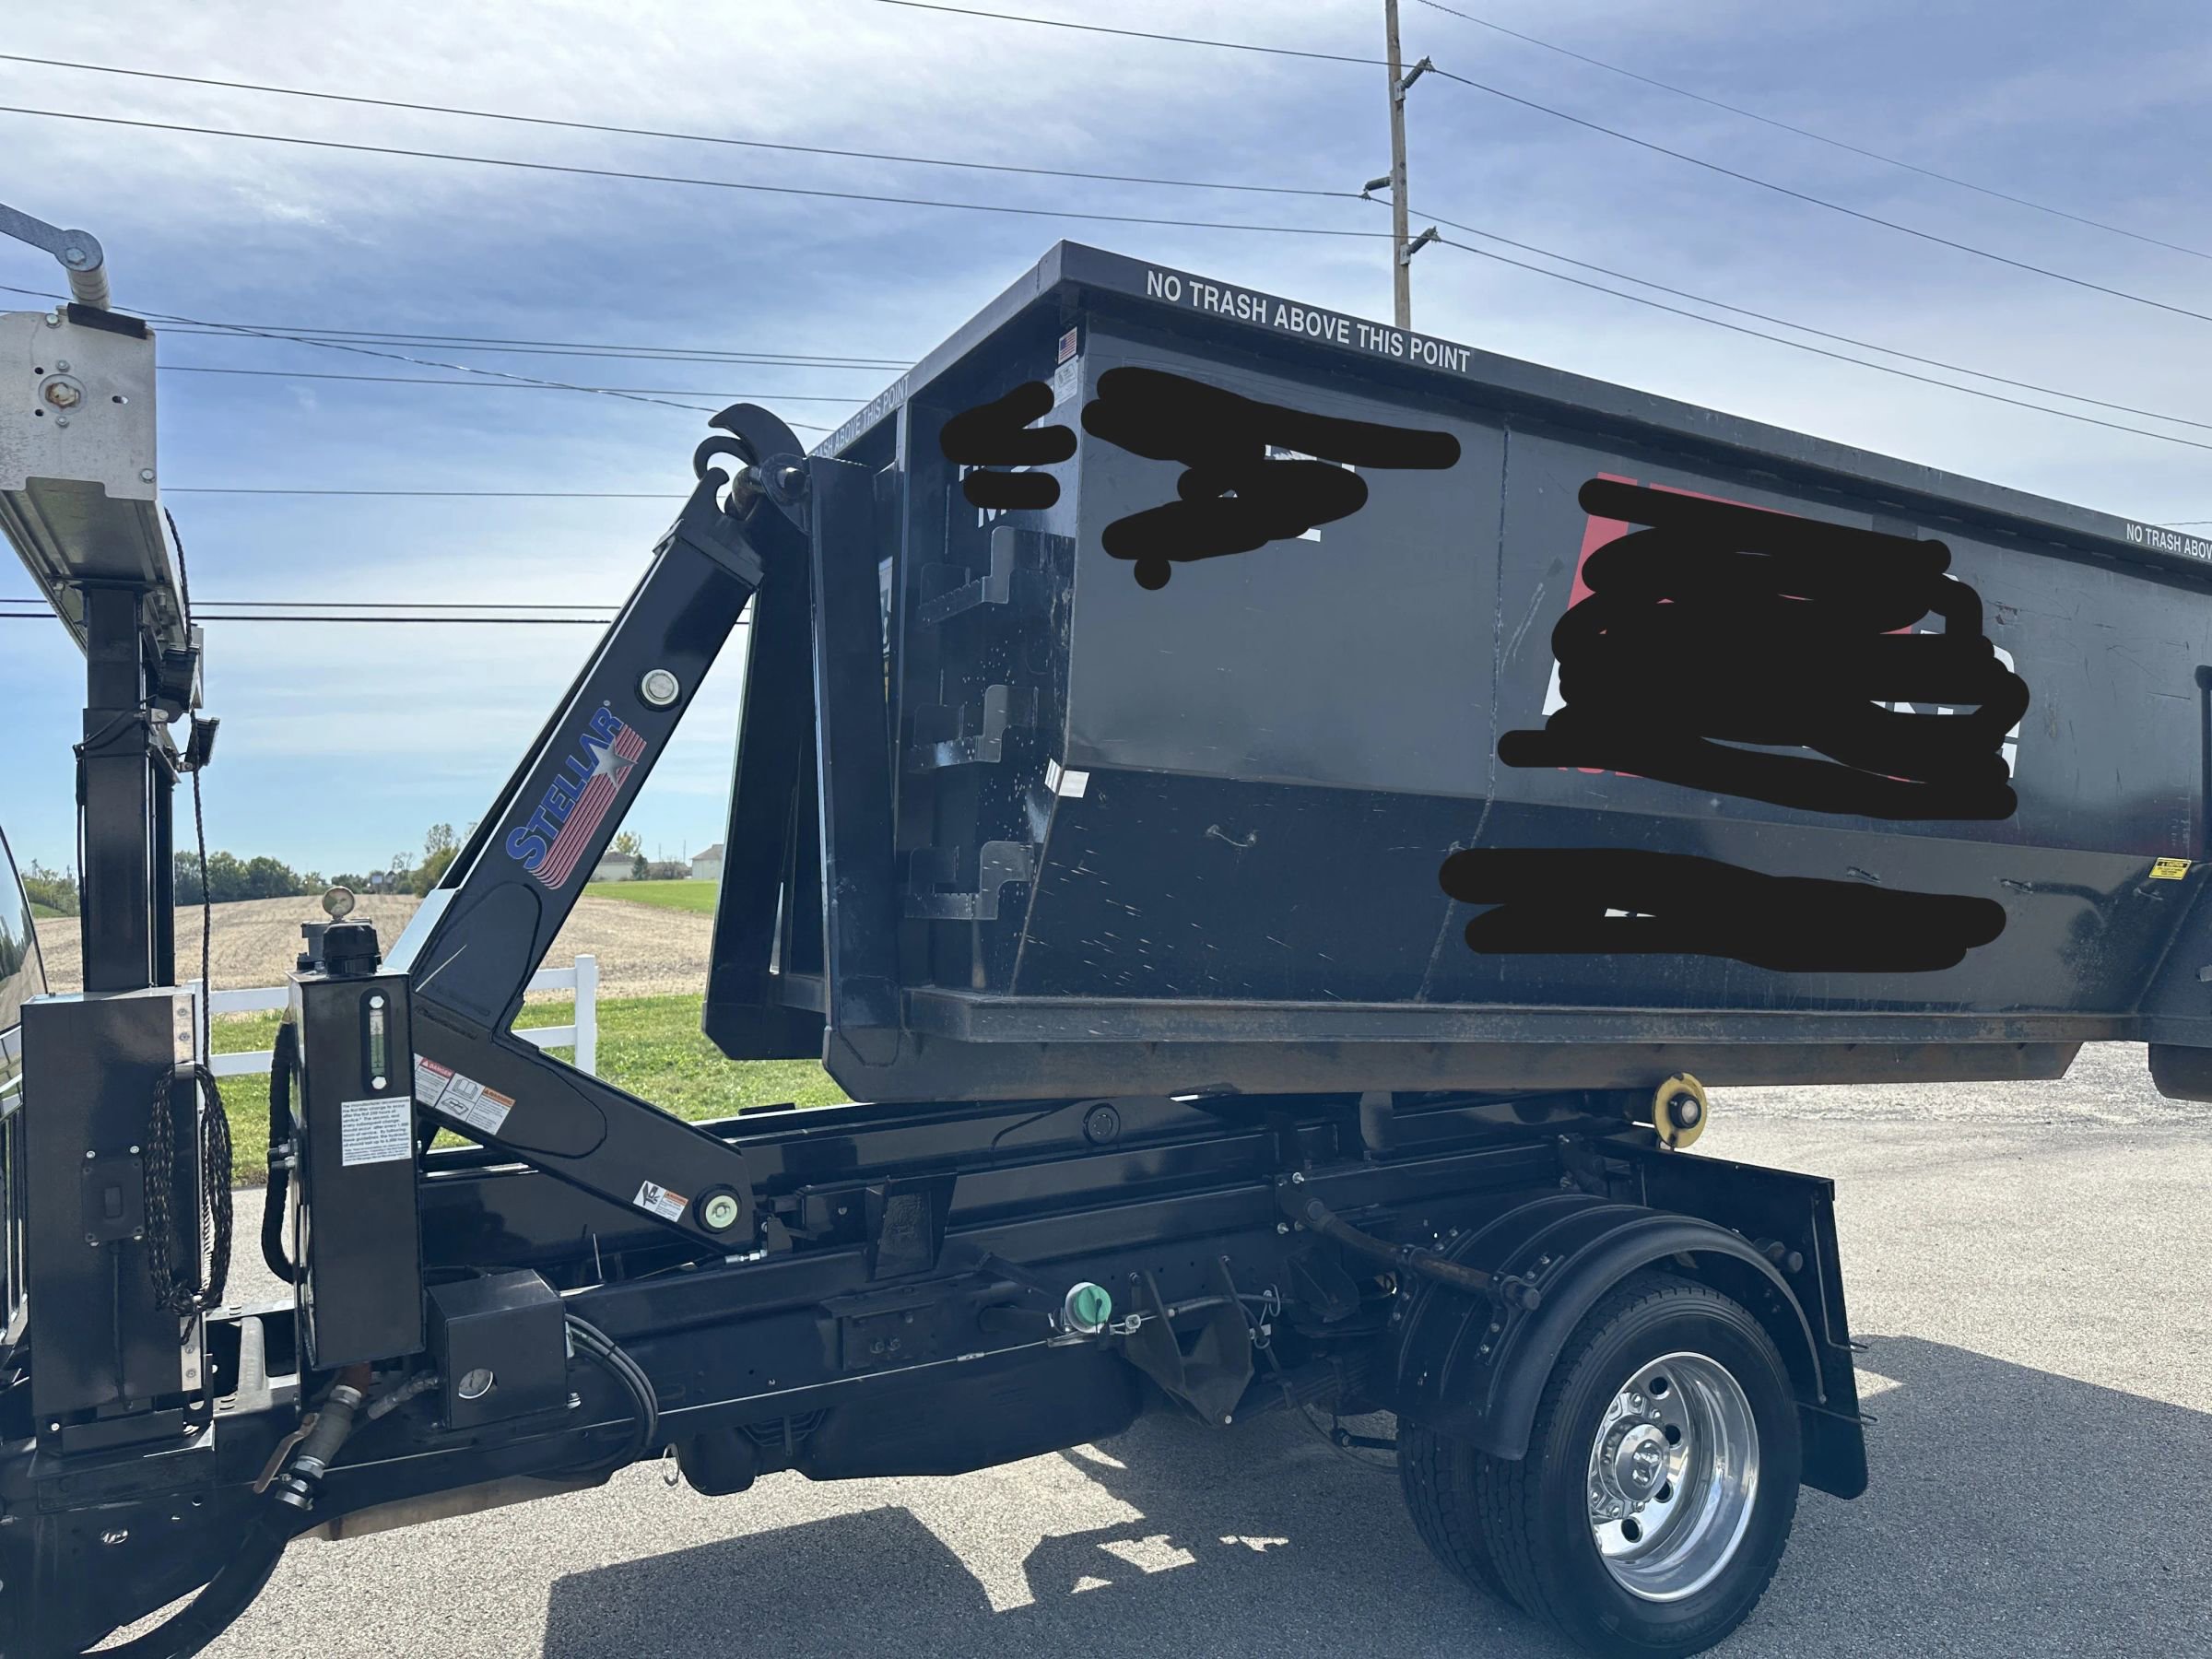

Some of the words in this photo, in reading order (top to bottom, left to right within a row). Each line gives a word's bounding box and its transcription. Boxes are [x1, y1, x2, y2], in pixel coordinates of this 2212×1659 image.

[1147, 270, 1181, 301] NO
[1190, 281, 1266, 324] TRASH
[1274, 304, 1349, 345] ABOVE
[1357, 323, 1404, 357] THIS
[1409, 337, 1470, 372] POINT
[834, 415, 861, 451] ABOVE
[863, 398, 881, 429] THIS
[883, 374, 910, 413] POINT
[2126, 524, 2142, 542] NO
[2146, 528, 2181, 552] TRASH
